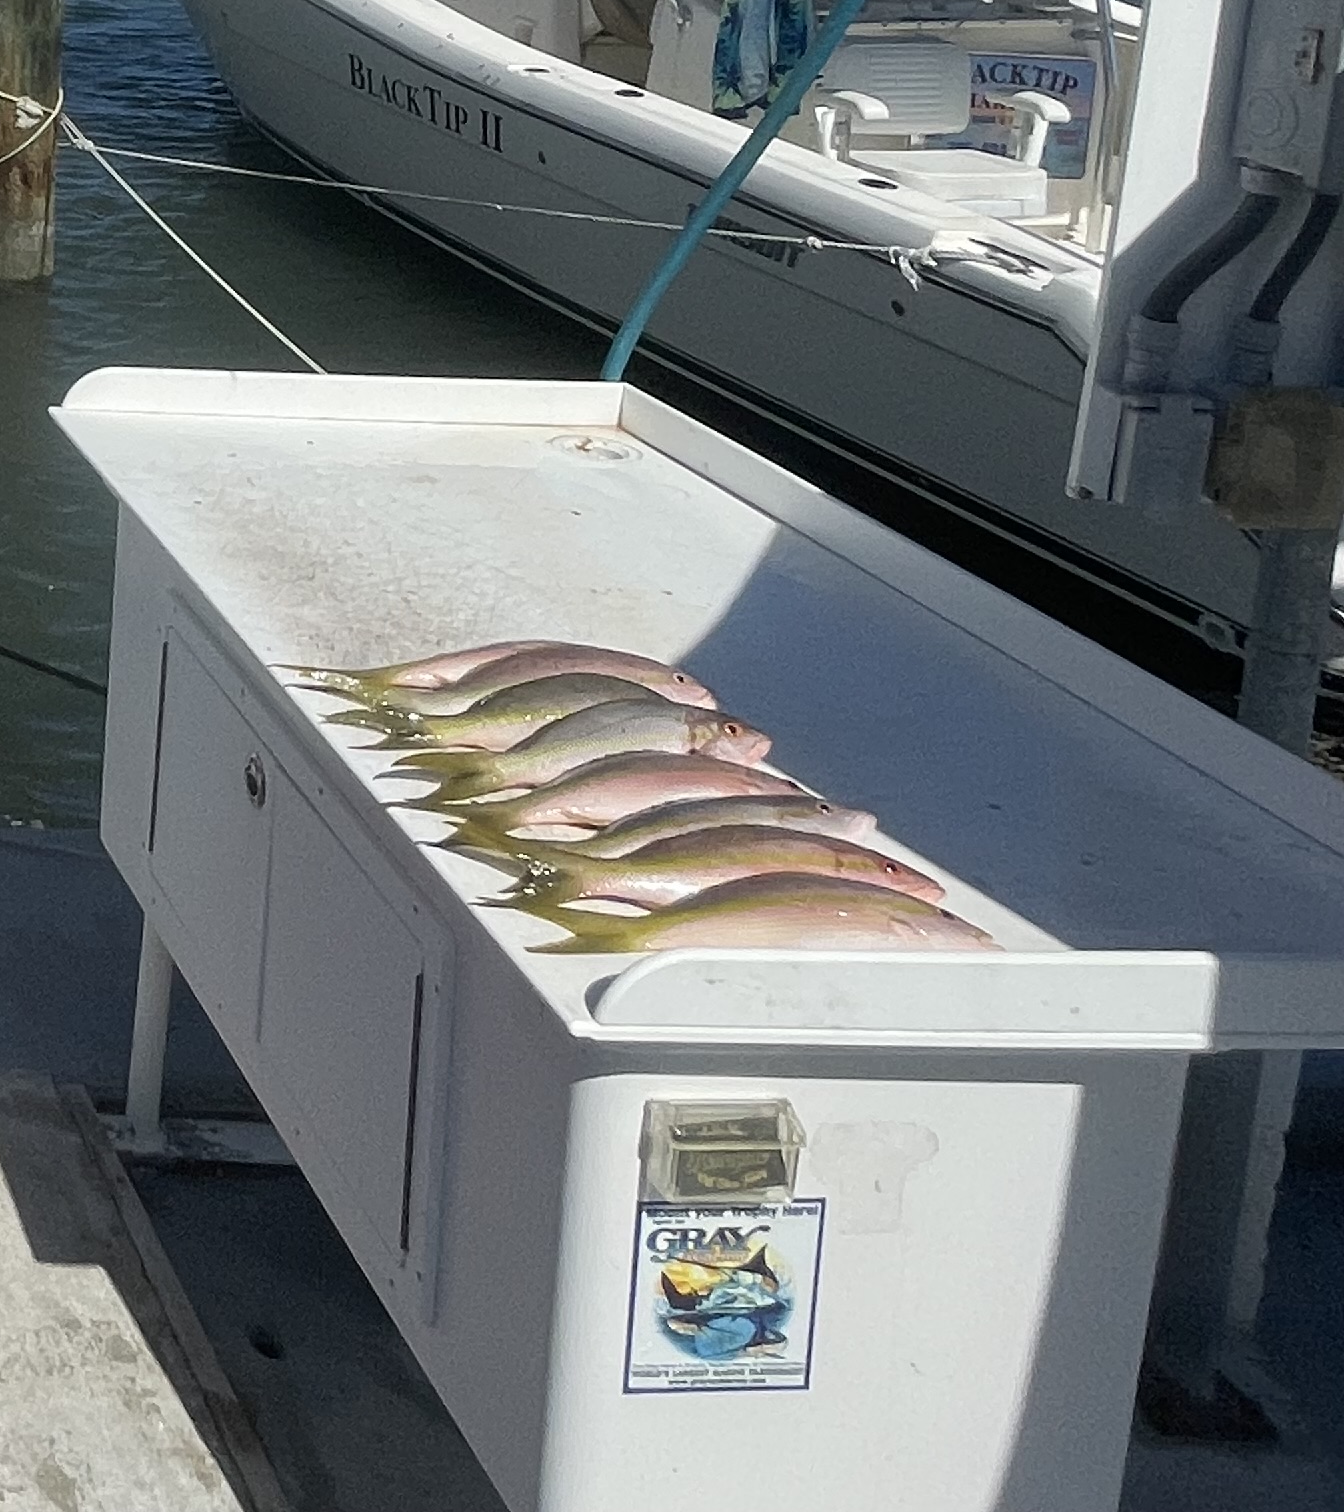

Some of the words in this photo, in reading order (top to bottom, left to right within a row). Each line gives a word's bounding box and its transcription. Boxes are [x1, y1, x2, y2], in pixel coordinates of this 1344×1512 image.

[971, 62, 1079, 95] ACKTIP
[479, 108, 504, 154] II
[646, 1224, 771, 1261] GRAY
